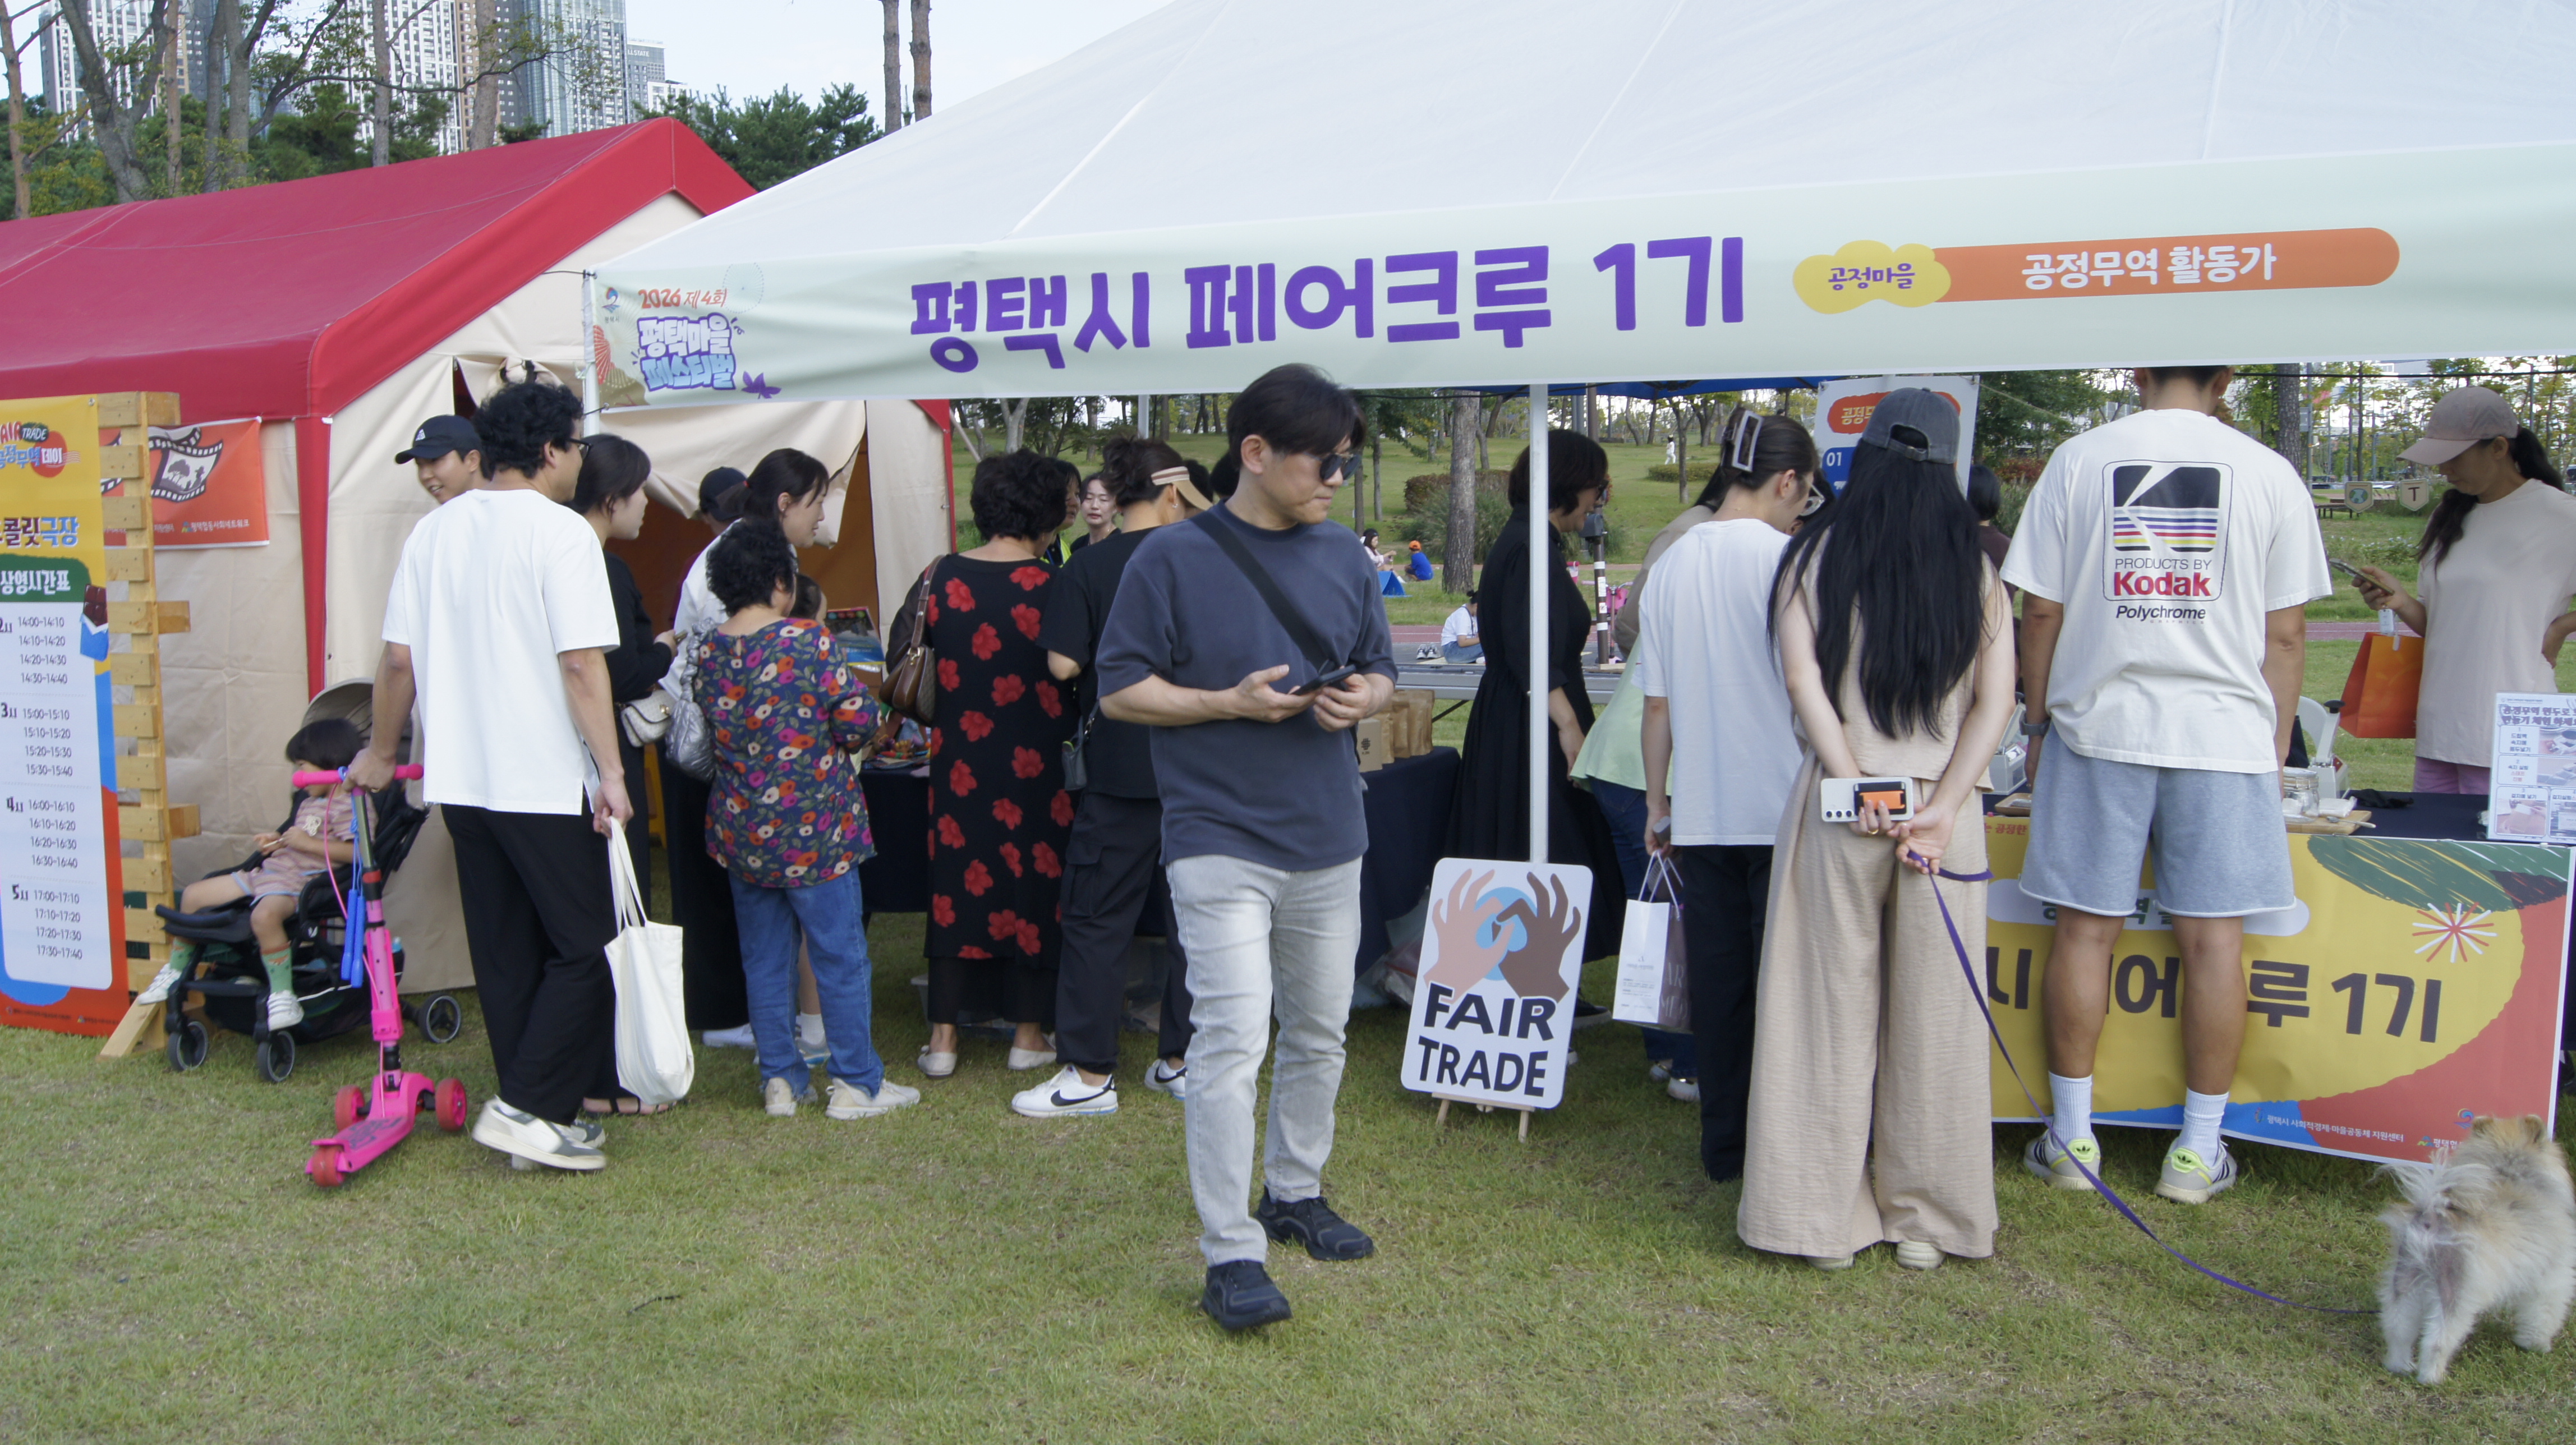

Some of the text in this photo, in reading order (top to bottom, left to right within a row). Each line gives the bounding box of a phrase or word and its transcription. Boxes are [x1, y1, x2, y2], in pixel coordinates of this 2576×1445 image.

[1828, 263, 1915, 291] 공정마을
[2022, 243, 2277, 290] 공정무역 활동가
[638, 288, 680, 309] 2026
[910, 236, 1744, 373] 평택시 페어크루 1기
[637, 312, 732, 357] 평택마을
[640, 354, 735, 392] 페스티벌
[0, 421, 47, 444] AIR TRADE
[41, 448, 63, 464] 데이
[1826, 452, 1842, 467] 01
[2408, 486, 2421, 501] T
[0, 516, 80, 549] 콜릿극장
[2115, 558, 2212, 570] PRODUCTS BY
[0, 569, 71, 595] 상영시간표
[2114, 571, 2211, 597] Kodak
[2116, 605, 2206, 622] Polychrome
[1995, 823, 2027, 835] 공정한
[1424, 982, 1557, 1042] FAIR
[2331, 973, 2442, 1043] 1기
[1418, 1035, 1548, 1098] TRADE
[2267, 1115, 2289, 1126] 평택시
[2372, 1130, 2404, 1143] 지원센터
